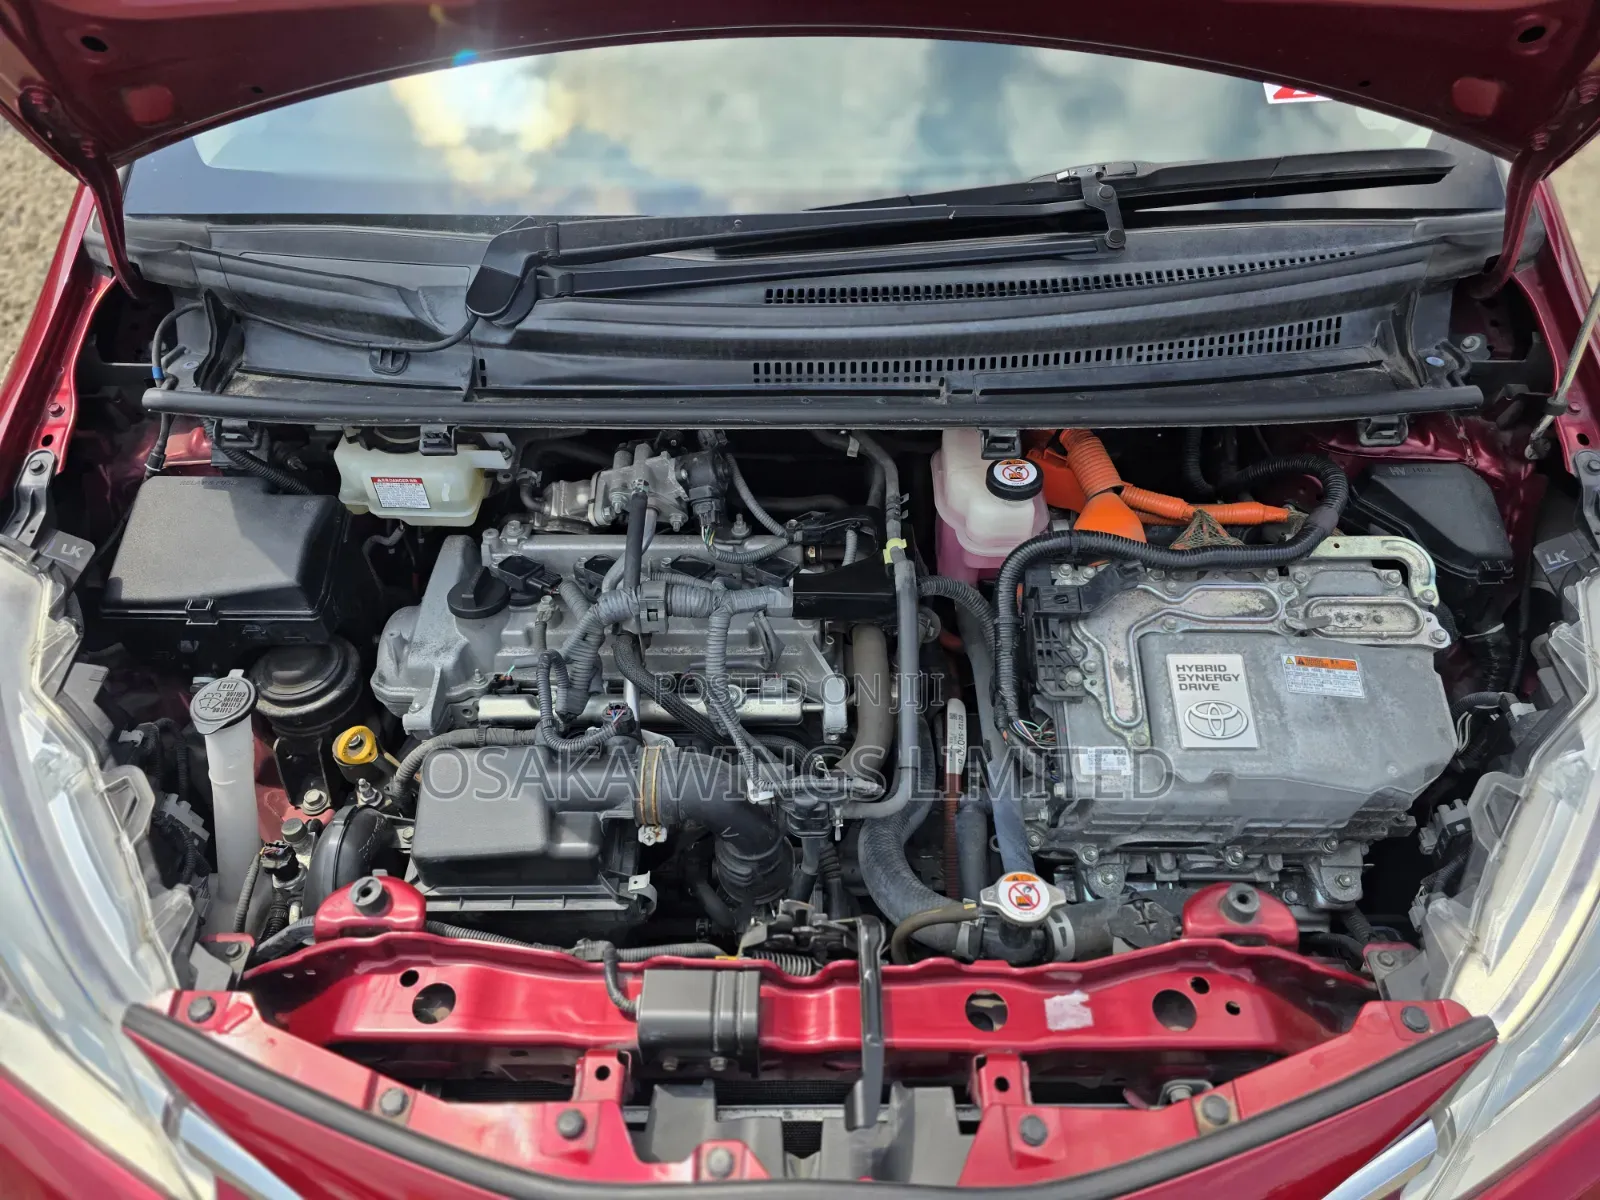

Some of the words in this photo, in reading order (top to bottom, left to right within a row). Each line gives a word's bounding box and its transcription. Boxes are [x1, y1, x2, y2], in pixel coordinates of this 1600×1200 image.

[61, 543, 84, 558] LK
[1545, 550, 1569, 565] LK
[1175, 664, 1227, 672] HYBRID
[1177, 673, 1240, 682] SYNERGY
[1179, 683, 1221, 691] DRIVE
